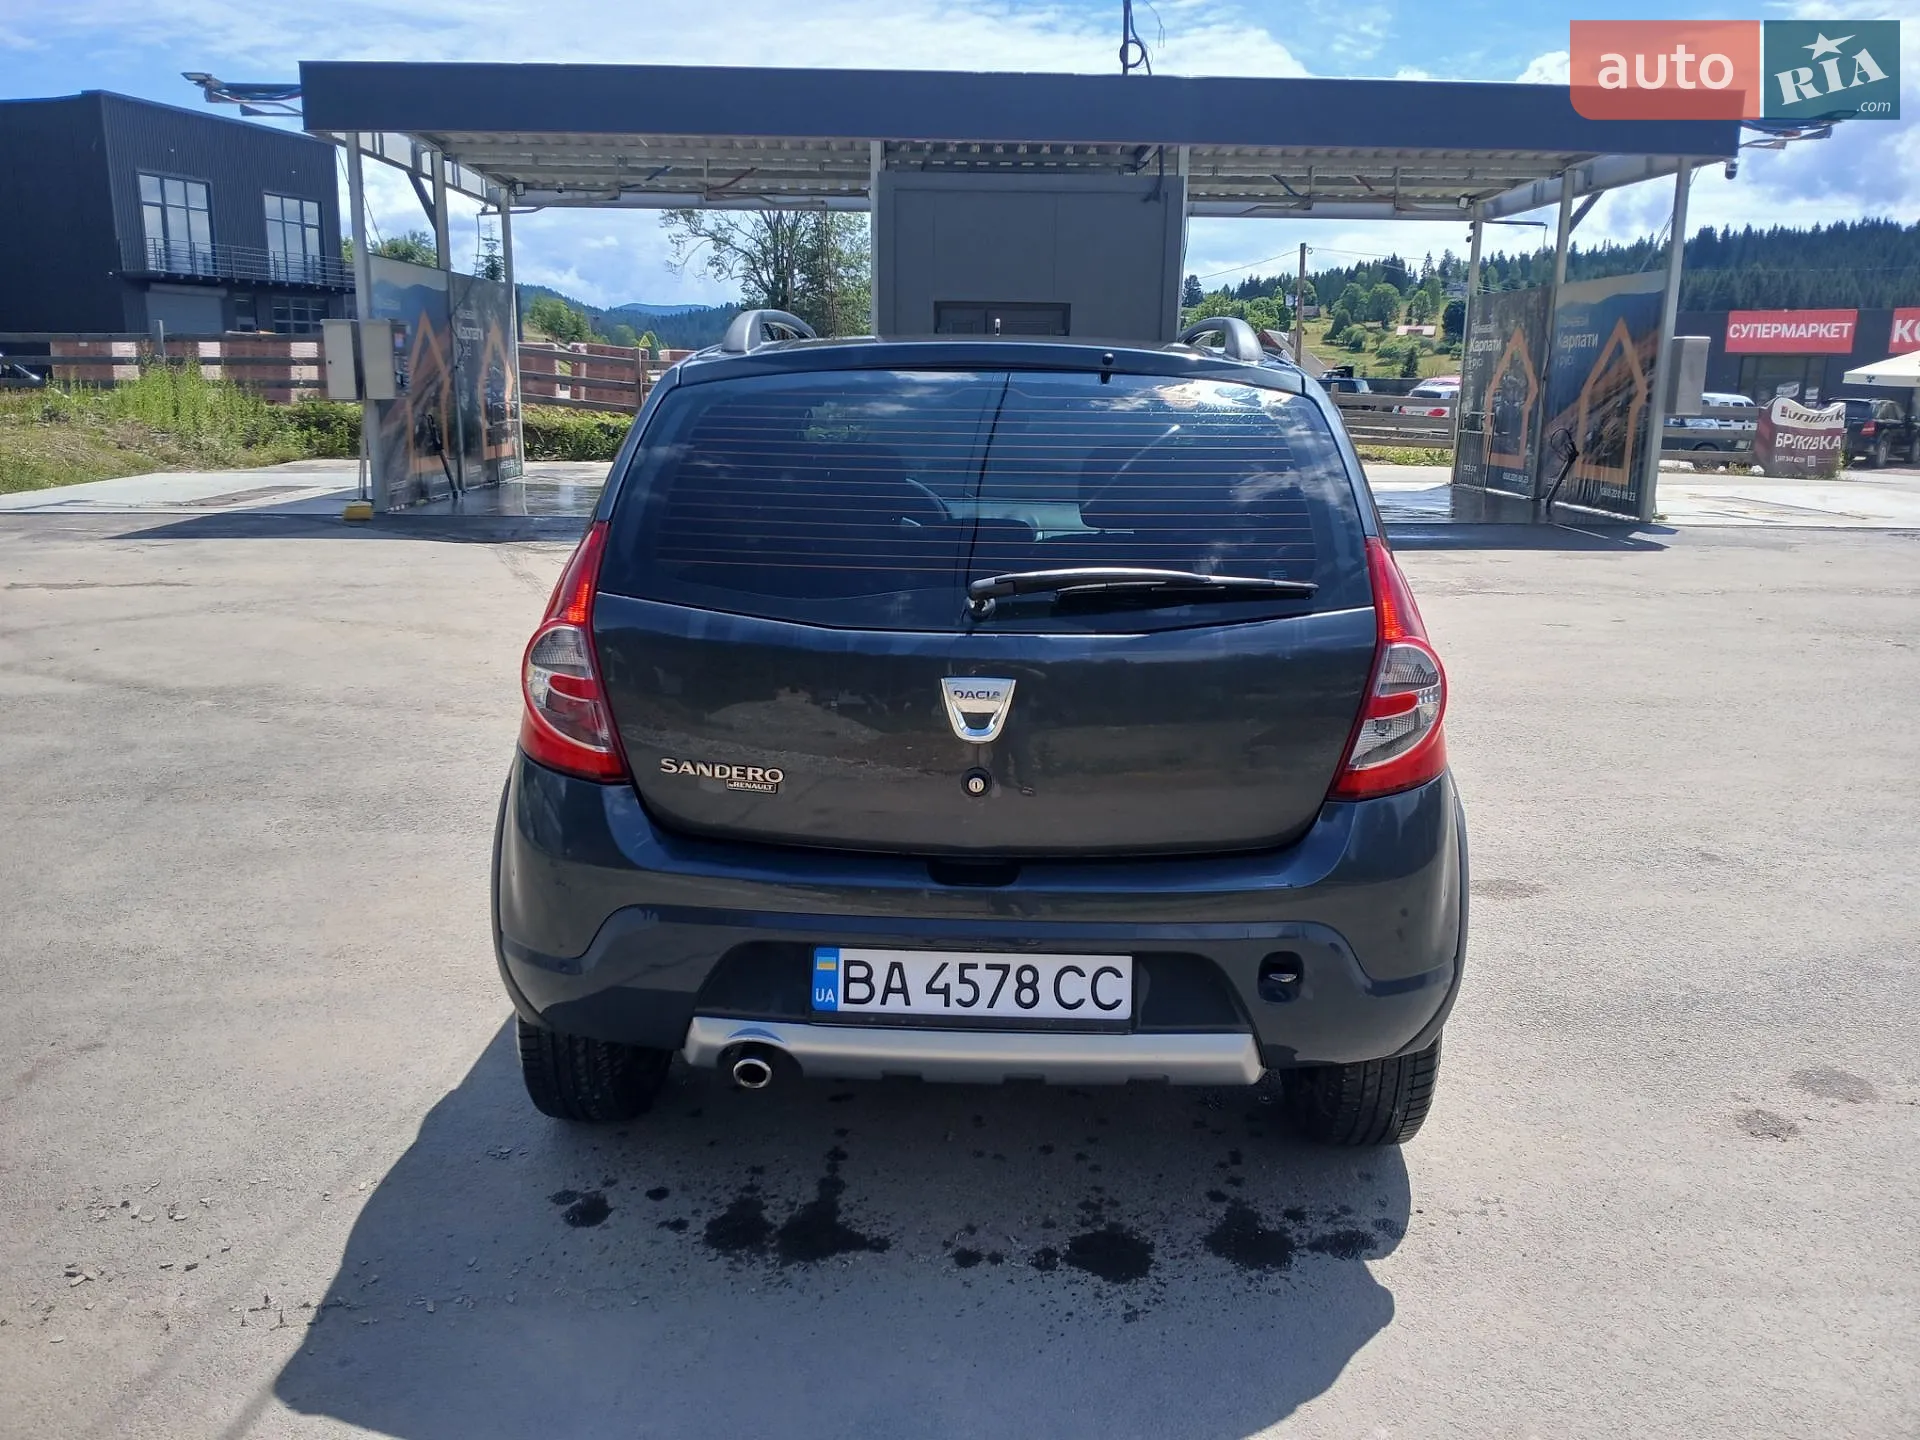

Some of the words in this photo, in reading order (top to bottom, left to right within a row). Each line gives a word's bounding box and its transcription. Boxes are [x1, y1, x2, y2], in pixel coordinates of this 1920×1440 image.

[1729, 323, 1852, 339] СУПЕРМАРКЕТ
[953, 690, 1001, 700] DACIA
[660, 757, 784, 783] SANDERO
[734, 781, 774, 791] RENAULT
[815, 987, 835, 1003] UA
[925, 961, 1040, 1010] 4578
